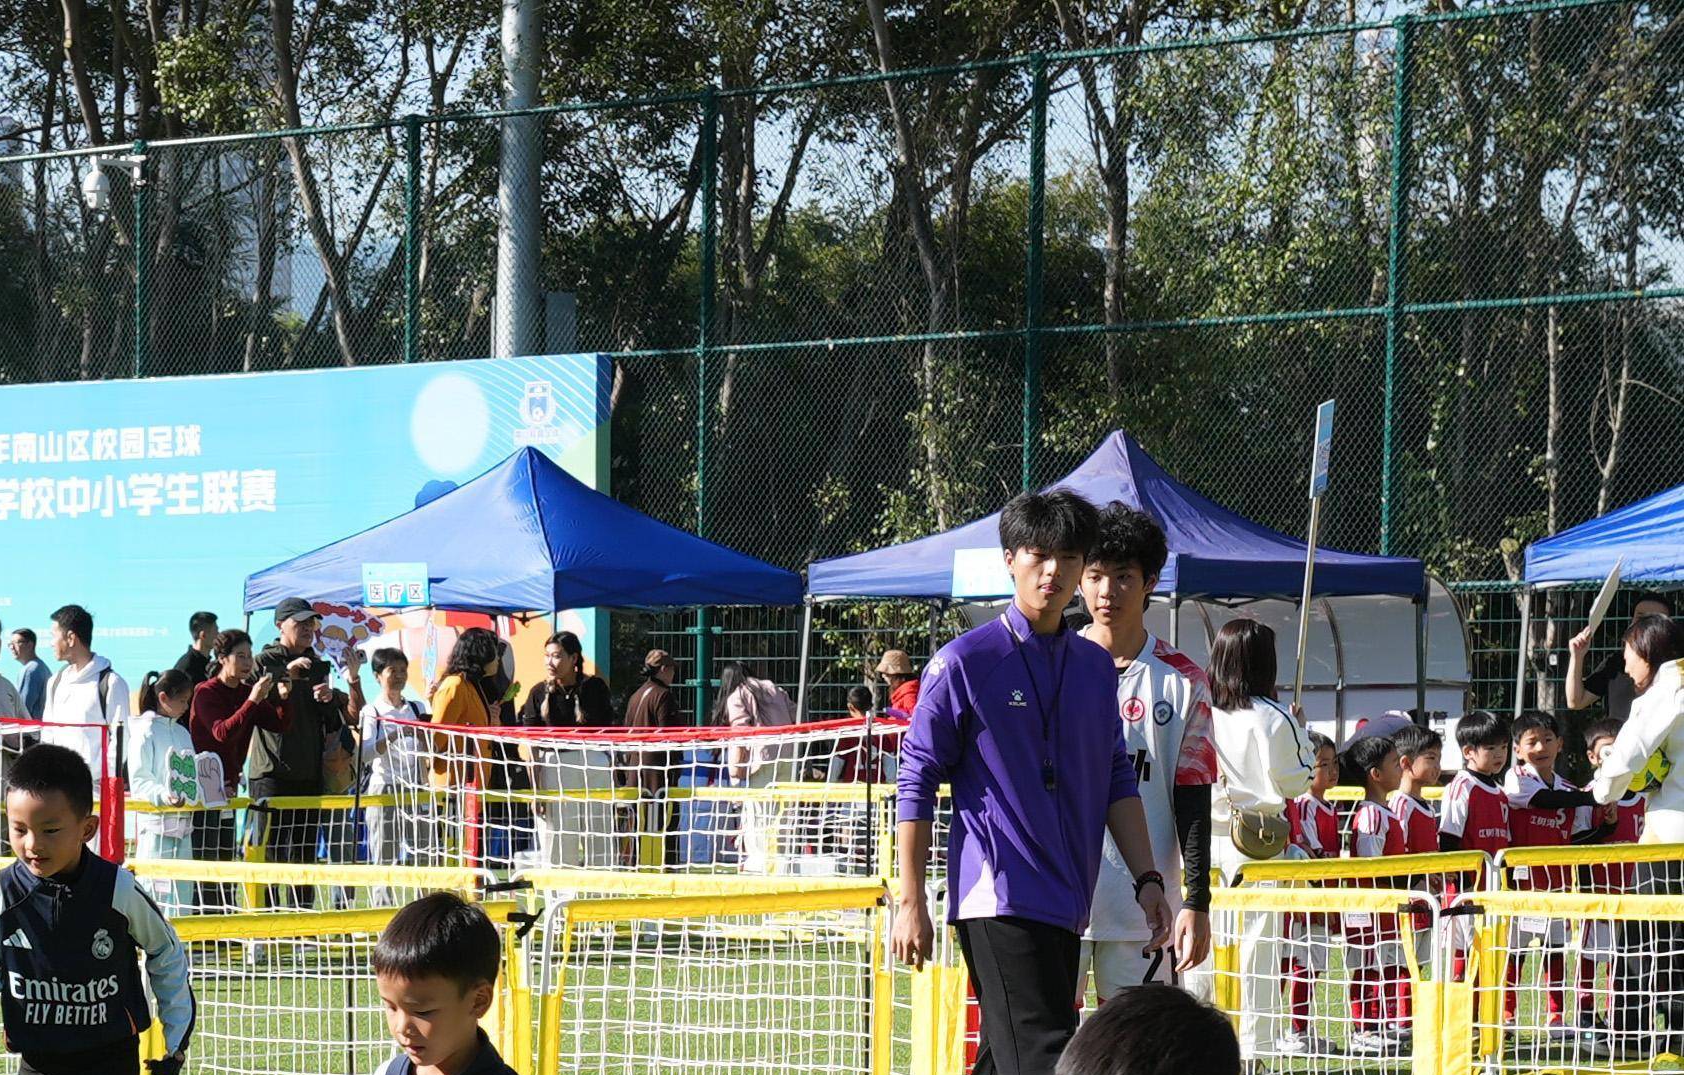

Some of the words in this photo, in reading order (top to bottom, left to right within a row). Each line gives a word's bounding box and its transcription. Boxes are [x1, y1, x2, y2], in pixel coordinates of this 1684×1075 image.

[369, 583, 422, 601] 医疗区
[8, 970, 119, 1003] Emirates
[25, 1002, 51, 1024] FLY
[54, 1002, 108, 1026] BETTER
